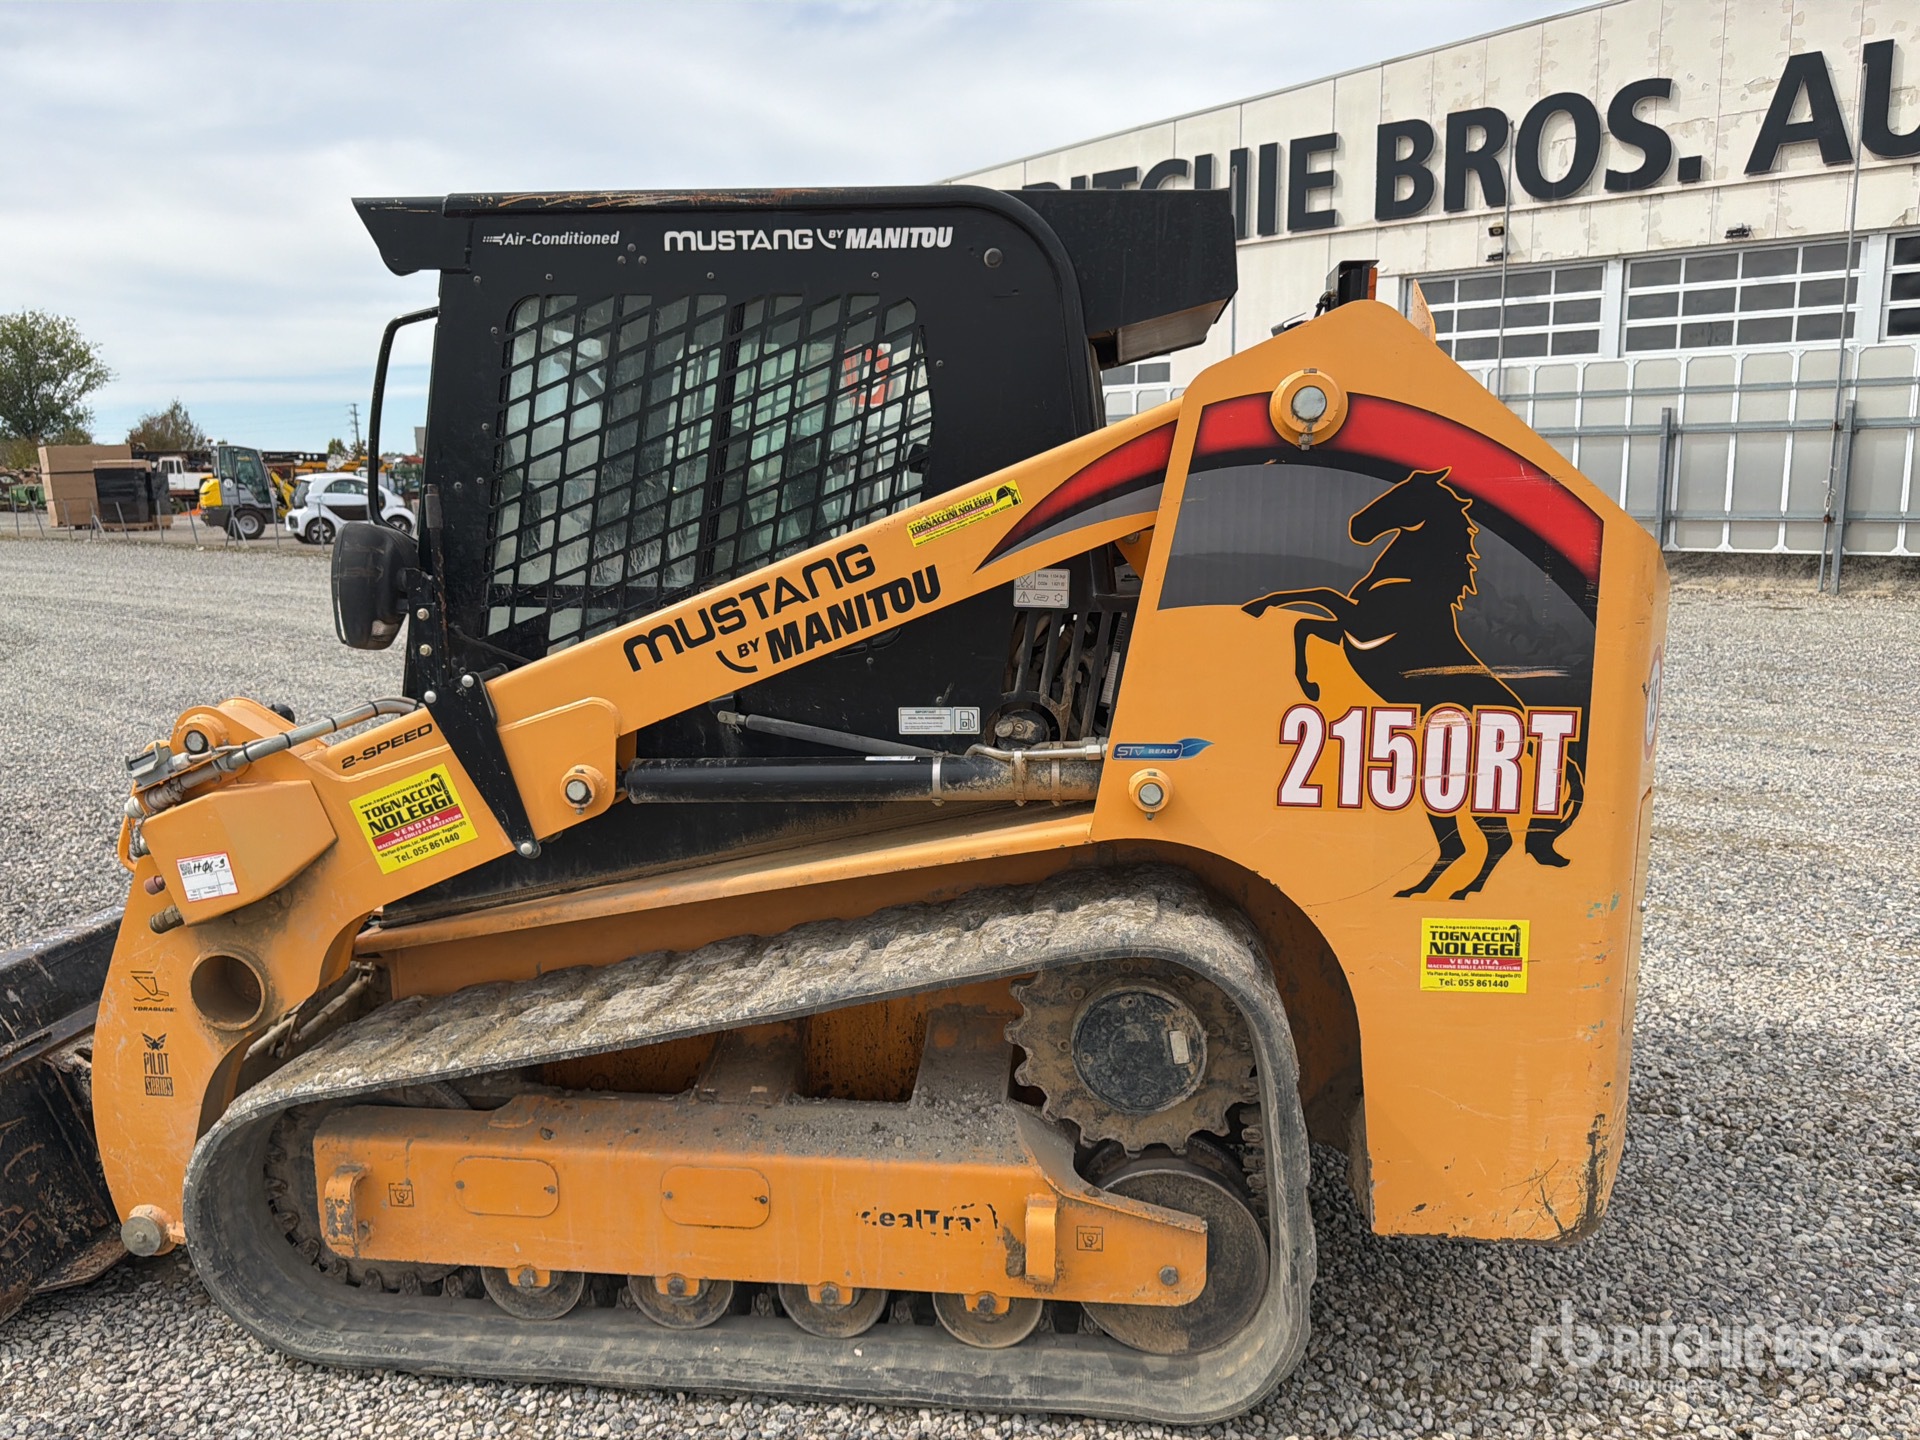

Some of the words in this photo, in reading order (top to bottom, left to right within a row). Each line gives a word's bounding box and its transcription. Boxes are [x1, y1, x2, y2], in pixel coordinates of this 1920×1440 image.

[1375, 77, 1702, 221] BROS.
[1745, 39, 1920, 174] AU
[504, 230, 620, 246] Air-Conditioned
[664, 229, 813, 251] MUSTANG
[828, 229, 844, 239] BY
[845, 226, 954, 249] MANITOU
[958, 496, 994, 515] NOLEGGI
[622, 543, 876, 673] MUSTANG
[736, 637, 761, 659] BY
[765, 564, 942, 664] MANITOU
[341, 723, 433, 770] 2-SPEED
[1276, 703, 1577, 815] 2150RT
[393, 815, 440, 837] VENDITA
[395, 852, 413, 863] Tel.
[413, 846, 429, 857] 055
[429, 832, 460, 851] 861440
[1449, 958, 1500, 966] VENDITA
[1439, 978, 1456, 987] Tel.
[1458, 979, 1477, 987] 055
[1476, 979, 1509, 988] 861440
[143, 1052, 169, 1075] PILOT
